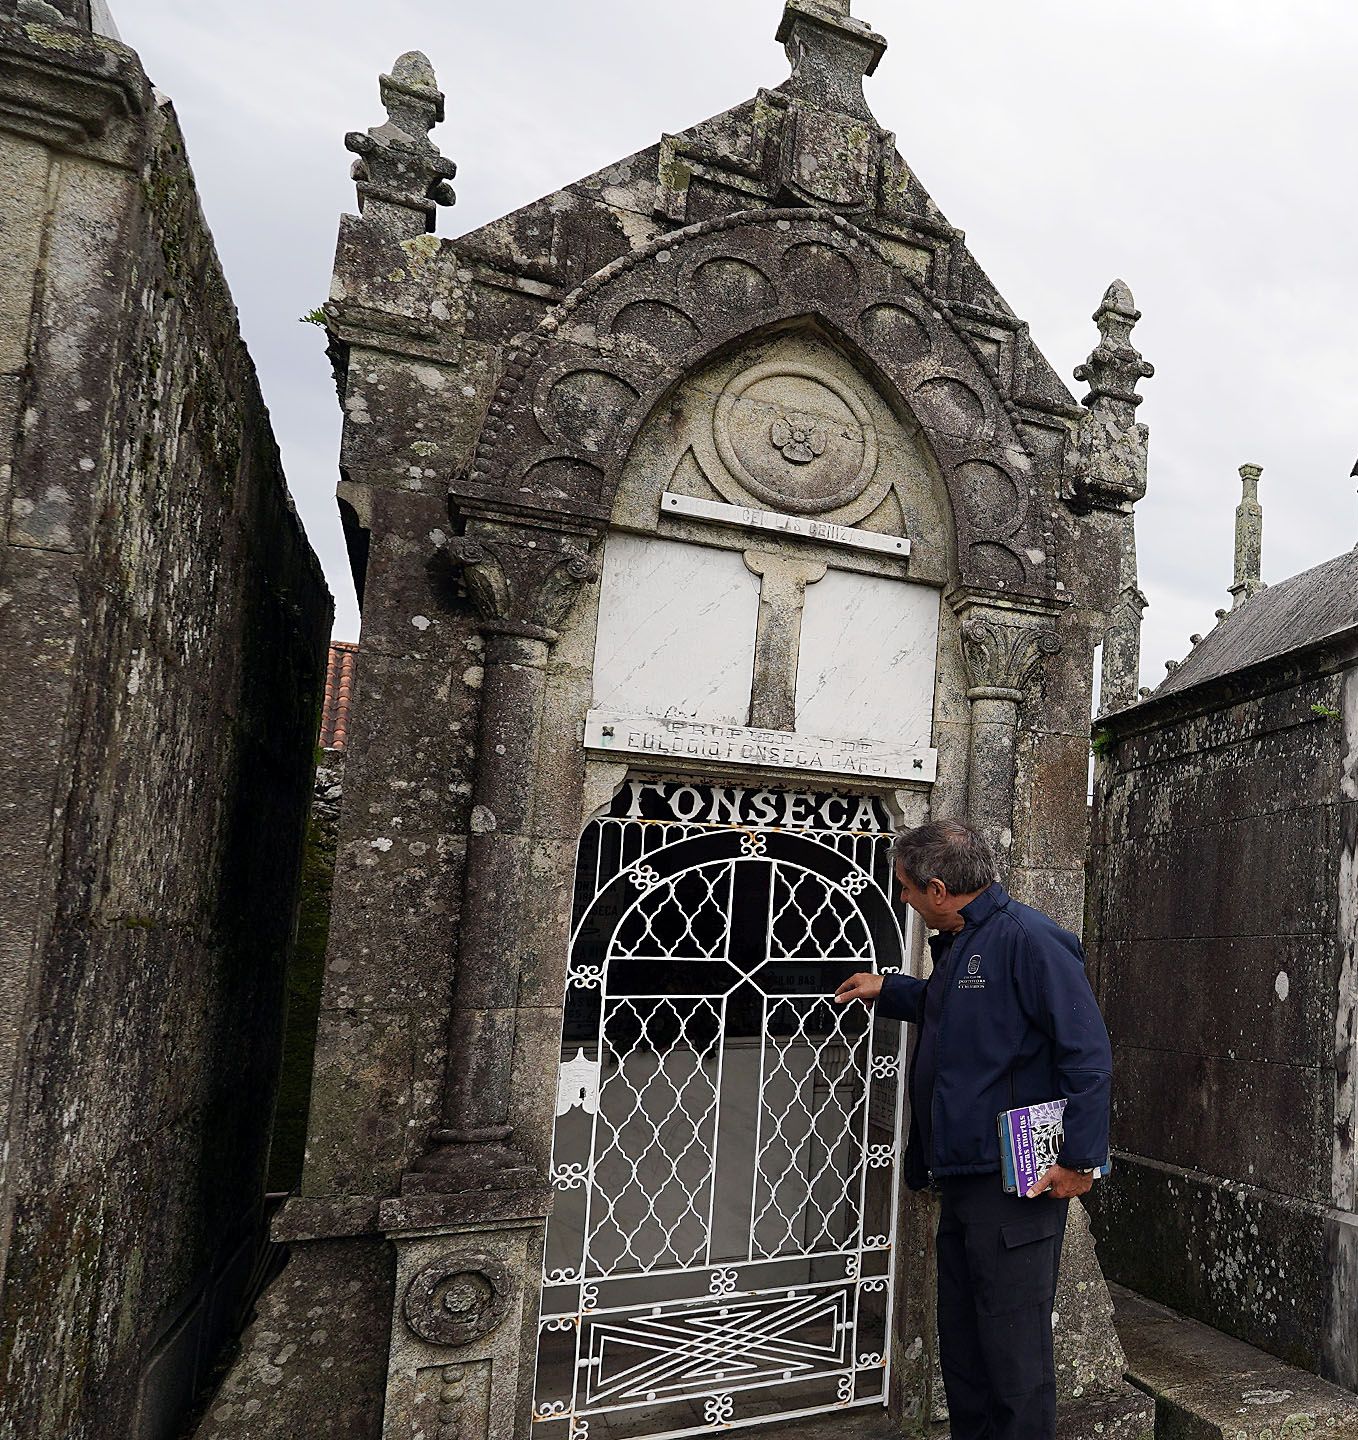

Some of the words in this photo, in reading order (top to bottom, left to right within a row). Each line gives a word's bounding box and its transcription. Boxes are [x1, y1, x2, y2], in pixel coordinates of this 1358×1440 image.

[627, 731, 721, 759] EULOGIO
[727, 743, 823, 769] FONSECA
[668, 721, 834, 750] PROPIEDAD
[840, 739, 873, 754] DE
[627, 781, 881, 831] FONSECA
[1019, 1115, 1029, 1148] mortas
[1023, 1150, 1034, 1176] horas
[1026, 1176, 1036, 1188] As
